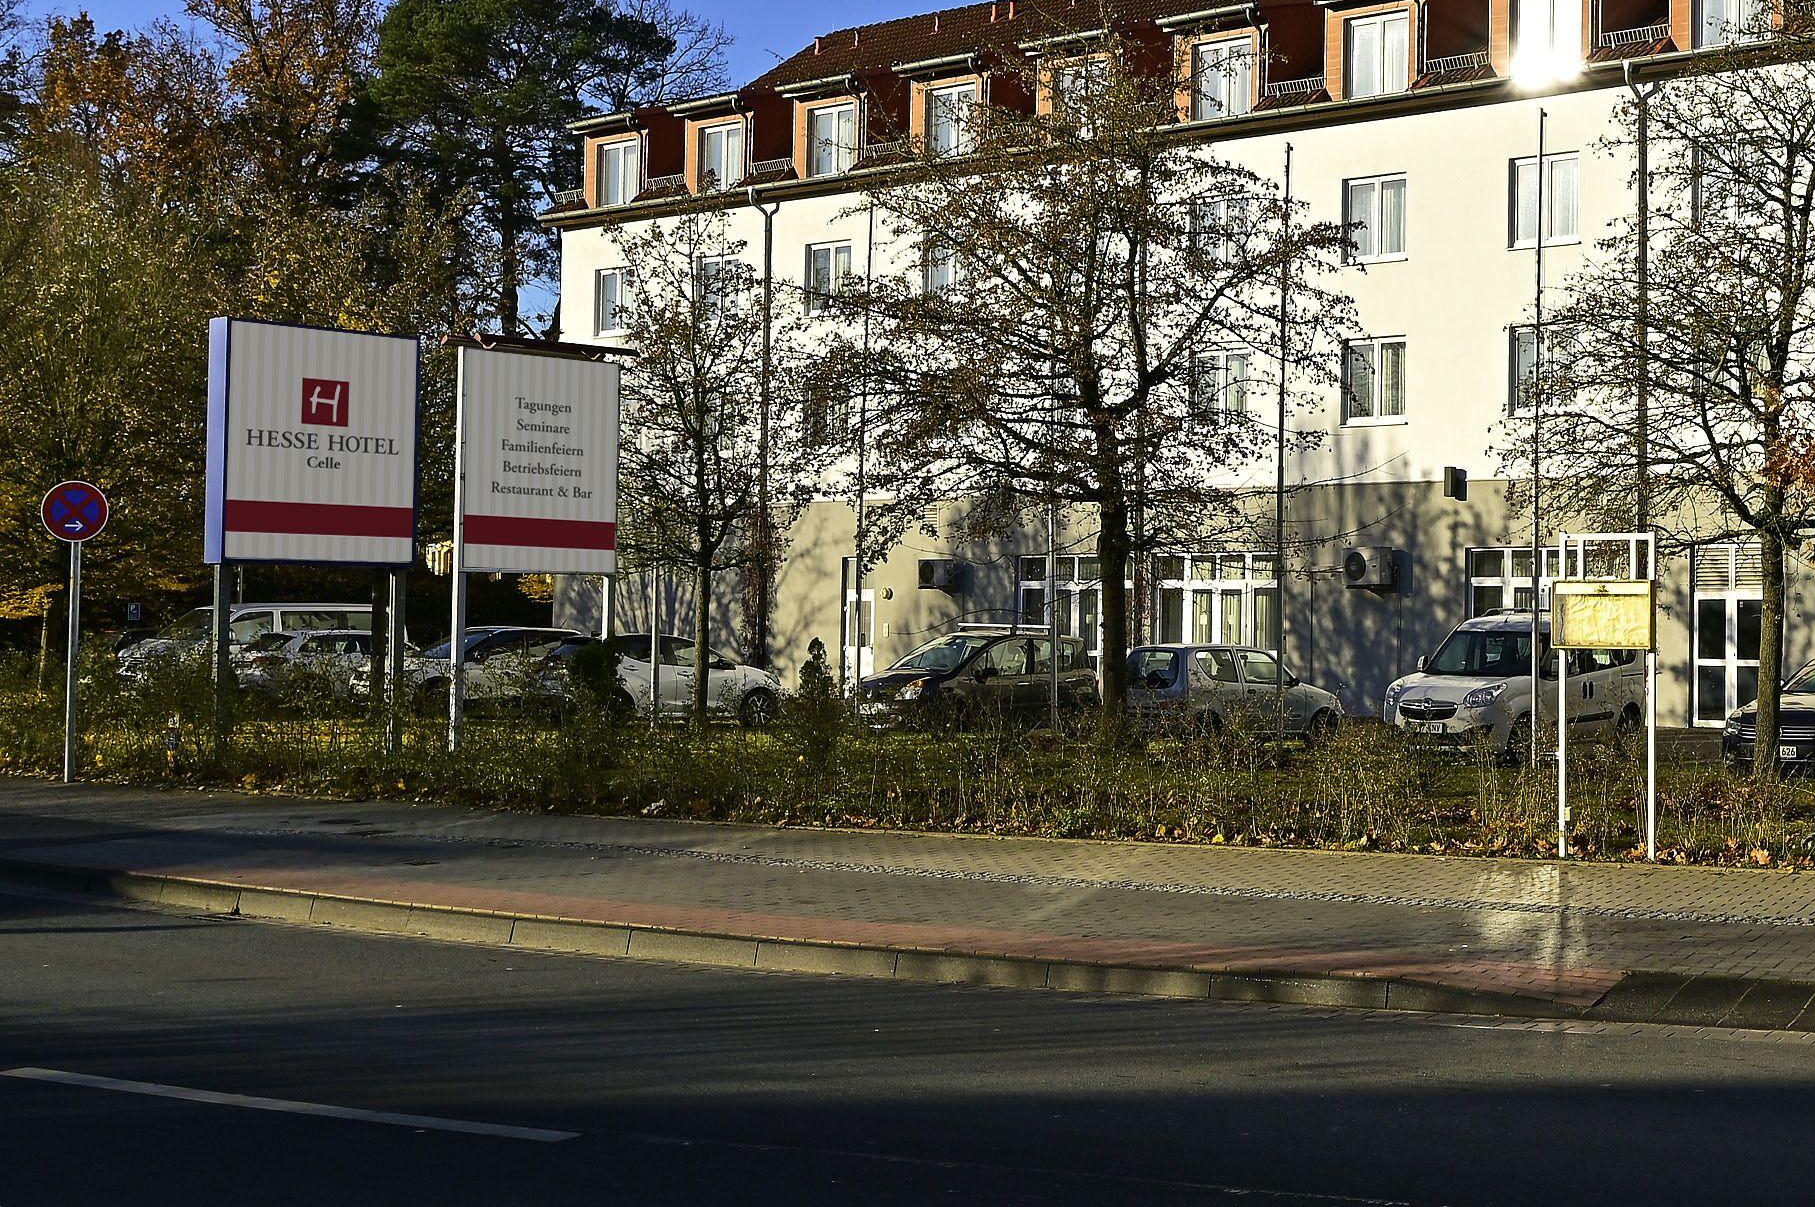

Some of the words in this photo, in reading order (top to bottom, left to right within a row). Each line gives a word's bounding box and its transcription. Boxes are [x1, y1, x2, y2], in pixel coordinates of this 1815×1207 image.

[310, 384, 341, 423] H
[515, 397, 572, 416] Tagungen
[516, 418, 570, 434] Seminare
[246, 429, 320, 450] HESSE
[328, 434, 399, 455] HOTEL
[501, 439, 584, 456] Familienfeiern
[307, 456, 341, 469] Celle
[503, 460, 582, 477] Betriebsfeiern
[491, 481, 554, 496] Restaurant
[558, 486, 568, 497] &
[573, 486, 592, 499] Bar
